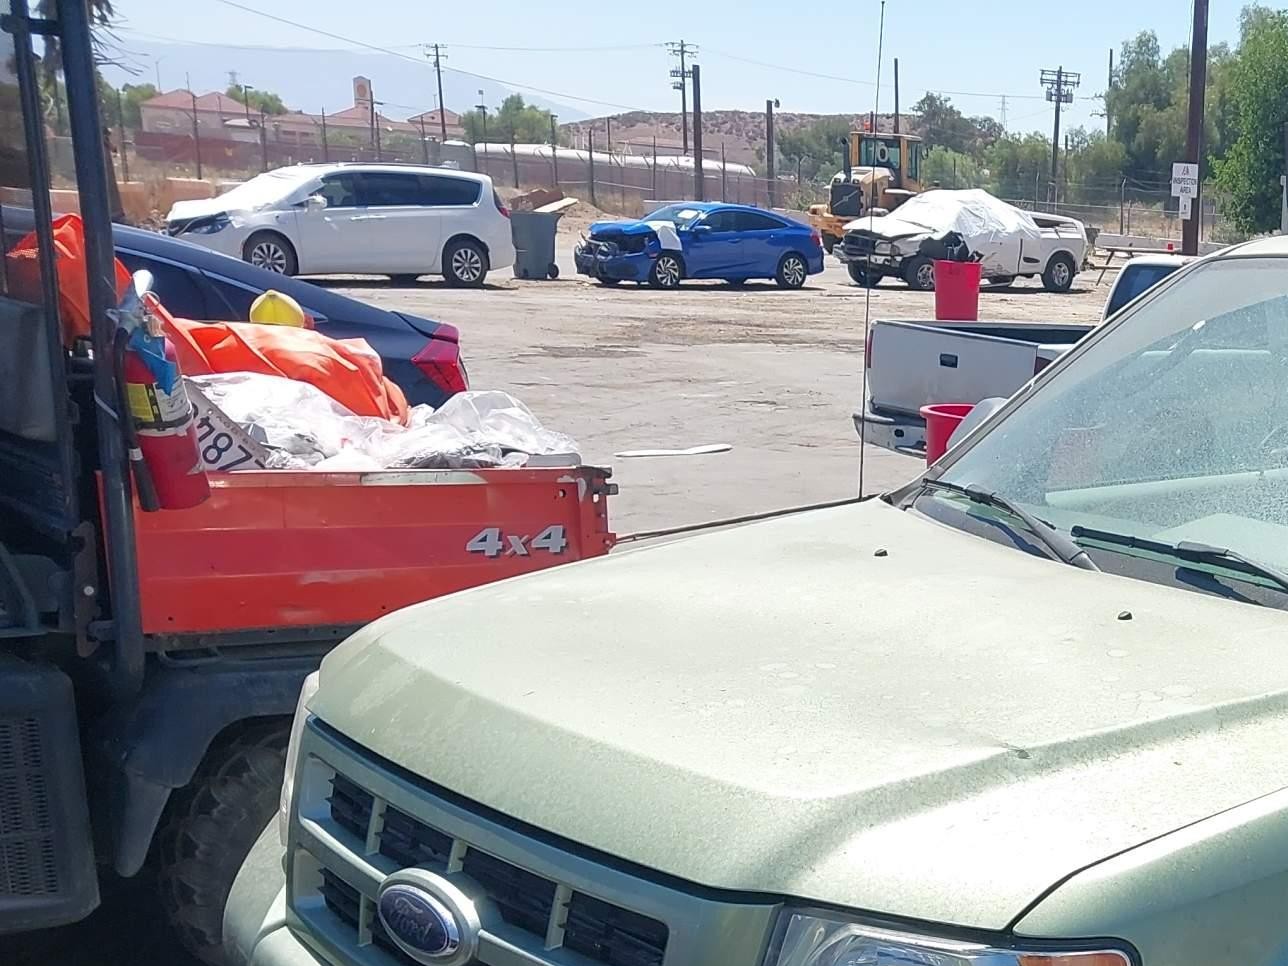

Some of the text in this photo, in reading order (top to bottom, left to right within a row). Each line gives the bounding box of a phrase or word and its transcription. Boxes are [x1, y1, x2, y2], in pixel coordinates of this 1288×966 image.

[1173, 177, 1197, 186] INSPECTION
[1180, 186, 1191, 194] AREA
[465, 524, 568, 557] 4x4
[389, 896, 434, 944] Ford
